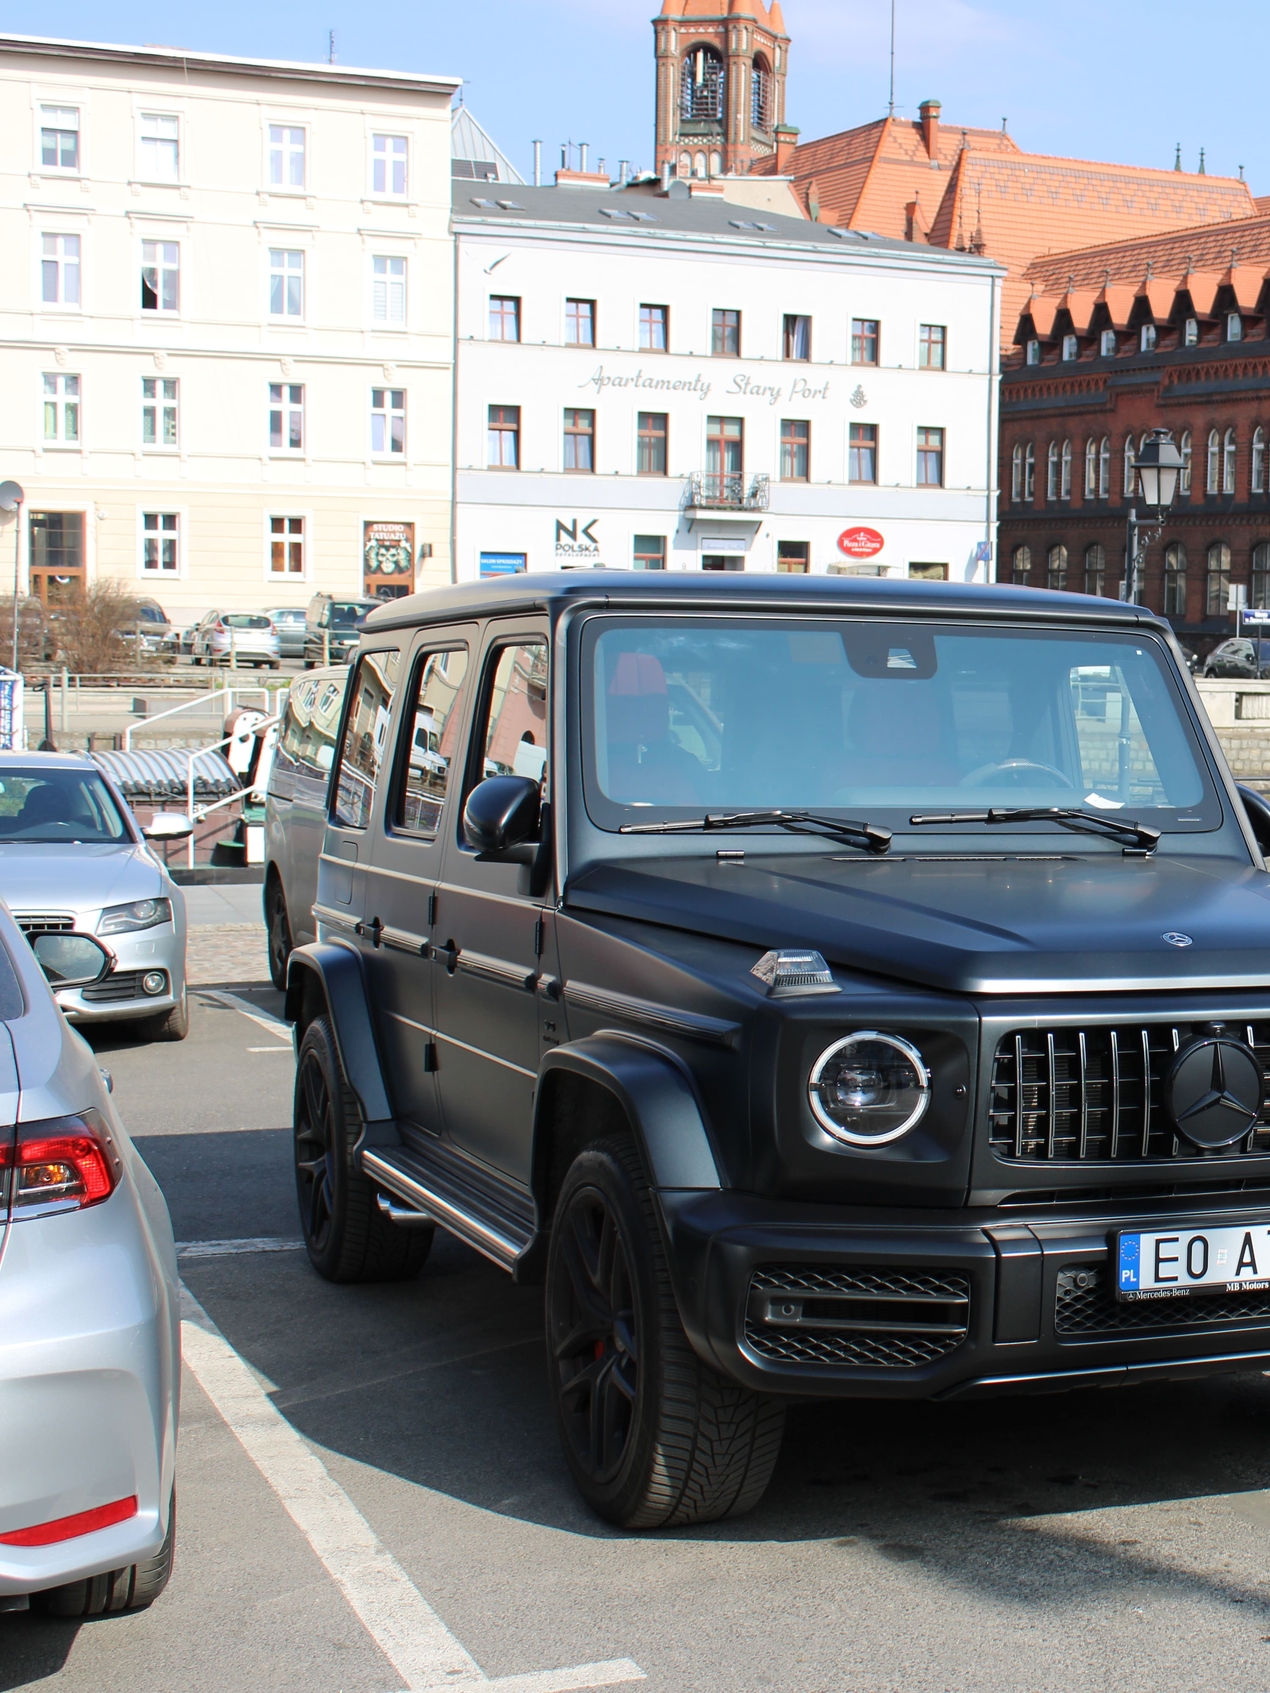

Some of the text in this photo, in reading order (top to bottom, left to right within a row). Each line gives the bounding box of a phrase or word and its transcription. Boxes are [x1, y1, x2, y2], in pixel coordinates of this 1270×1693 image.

[577, 365, 829, 405] Apartamenty Stary Port
[372, 524, 404, 532] STUDIO
[555, 518, 599, 543] NK
[555, 543, 599, 552] POLSKA
[843, 539, 858, 547] Pizza
[1122, 1269, 1138, 1282] PL
[1226, 1280, 1269, 1292] MB Motors
[1136, 1288, 1190, 1300] Mercedes-Benz
